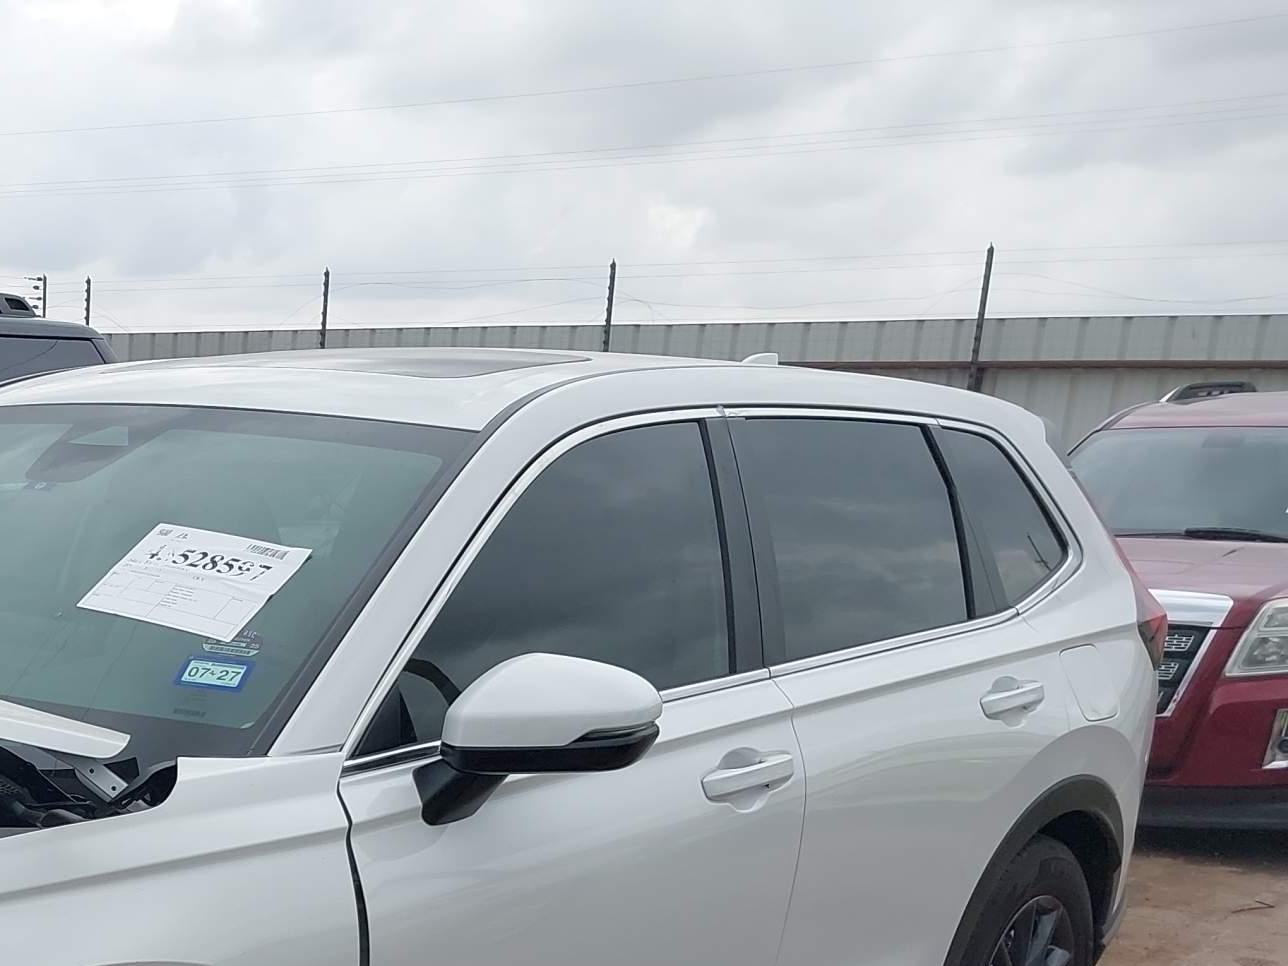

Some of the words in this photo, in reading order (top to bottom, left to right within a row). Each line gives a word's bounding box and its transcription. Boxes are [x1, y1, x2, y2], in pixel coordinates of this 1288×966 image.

[145, 543, 274, 582] 4528597
[187, 666, 211, 679] 07
[216, 669, 242, 682] 27
